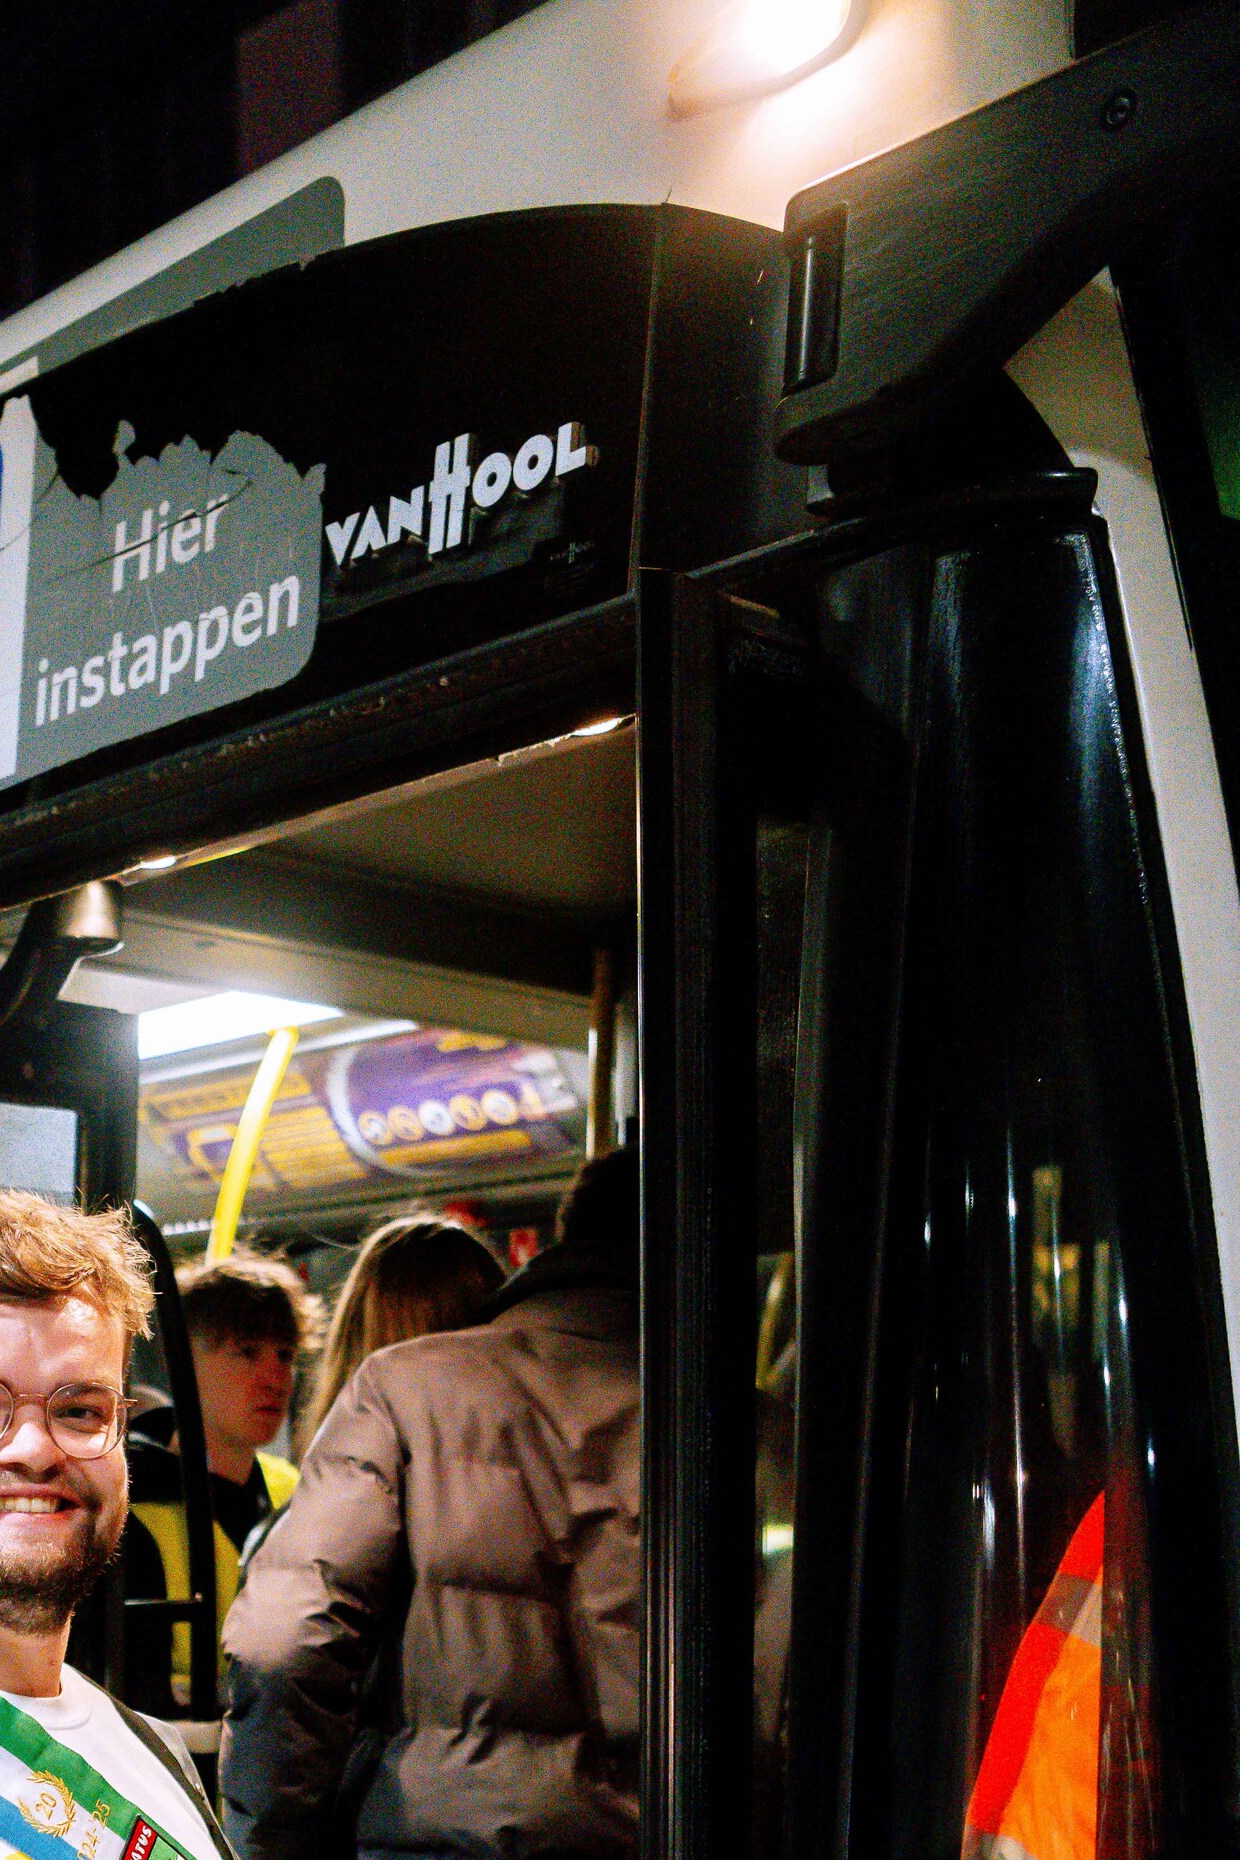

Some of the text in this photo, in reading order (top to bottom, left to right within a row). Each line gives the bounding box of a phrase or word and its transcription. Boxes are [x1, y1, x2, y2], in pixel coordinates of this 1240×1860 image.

[112, 493, 228, 592] Hier
[35, 575, 300, 727] instappen
[34, 1792, 57, 1821] 20
